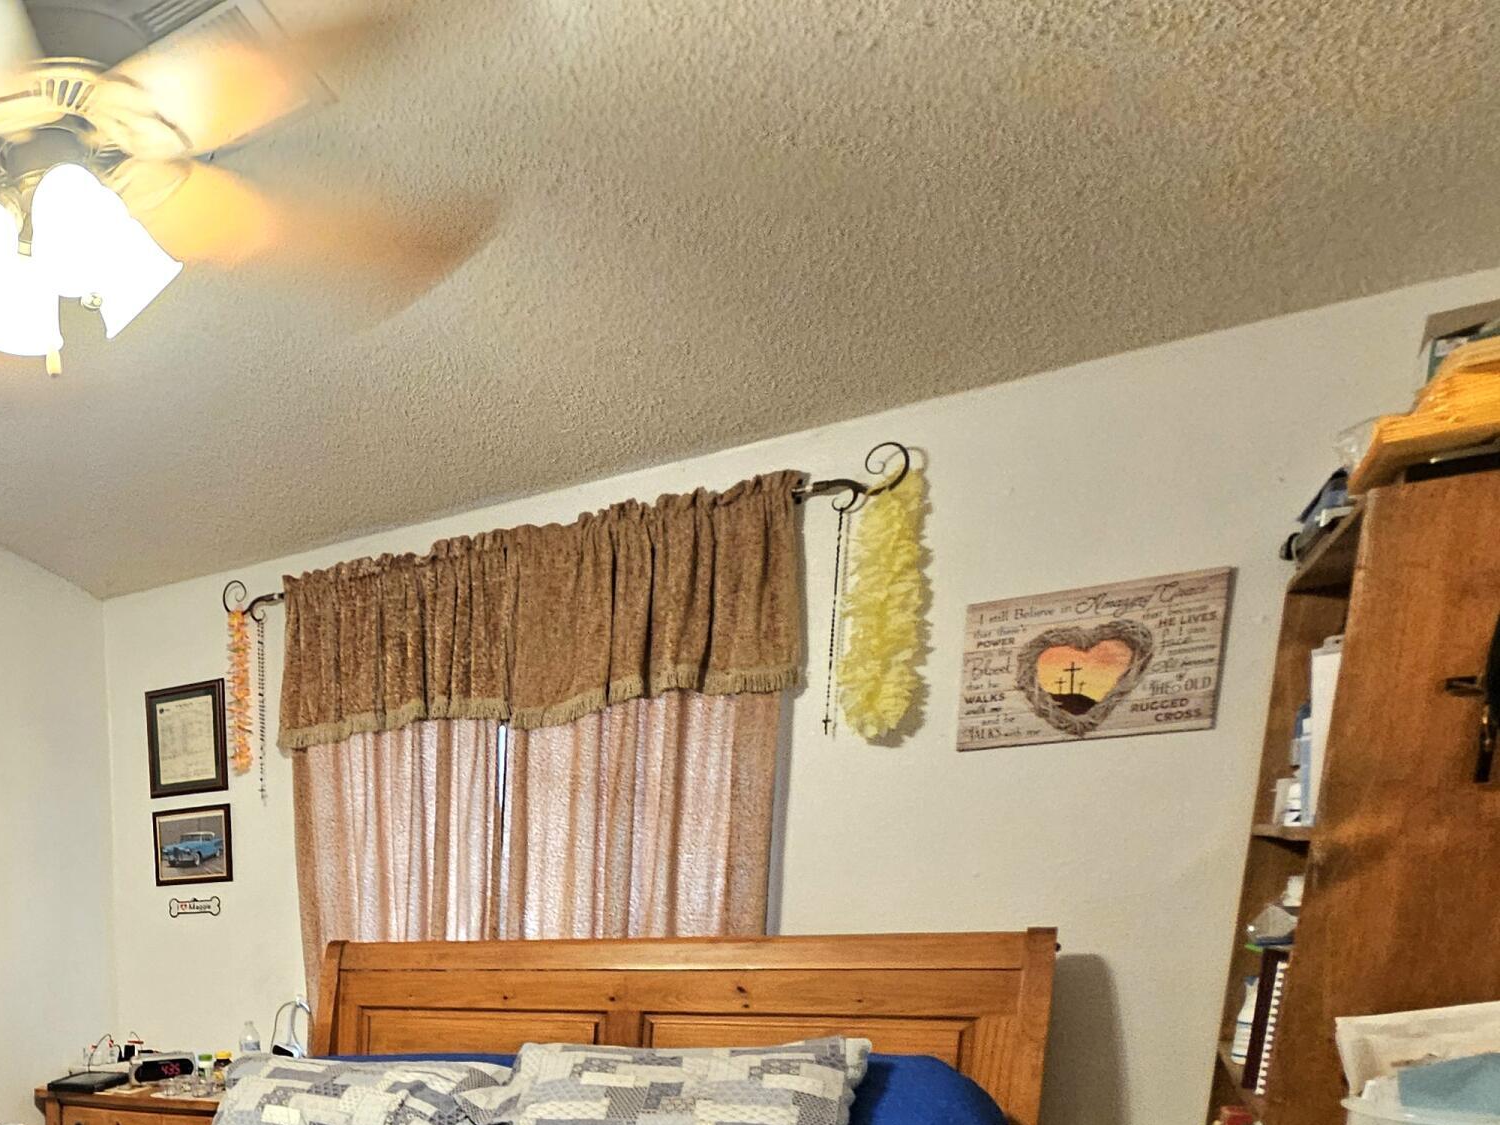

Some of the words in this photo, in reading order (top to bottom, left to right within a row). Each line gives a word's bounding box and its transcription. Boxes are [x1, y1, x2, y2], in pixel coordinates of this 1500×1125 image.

[1014, 607, 1055, 621] Believe
[1157, 617, 1177, 628] HE
[1181, 610, 1218, 625] LIVES
[976, 637, 1015, 649] POWER
[1184, 676, 1212, 691] OLD
[963, 692, 1006, 705] WALKS
[1130, 698, 1190, 712] RUGGED
[1154, 708, 1203, 722] CROSS
